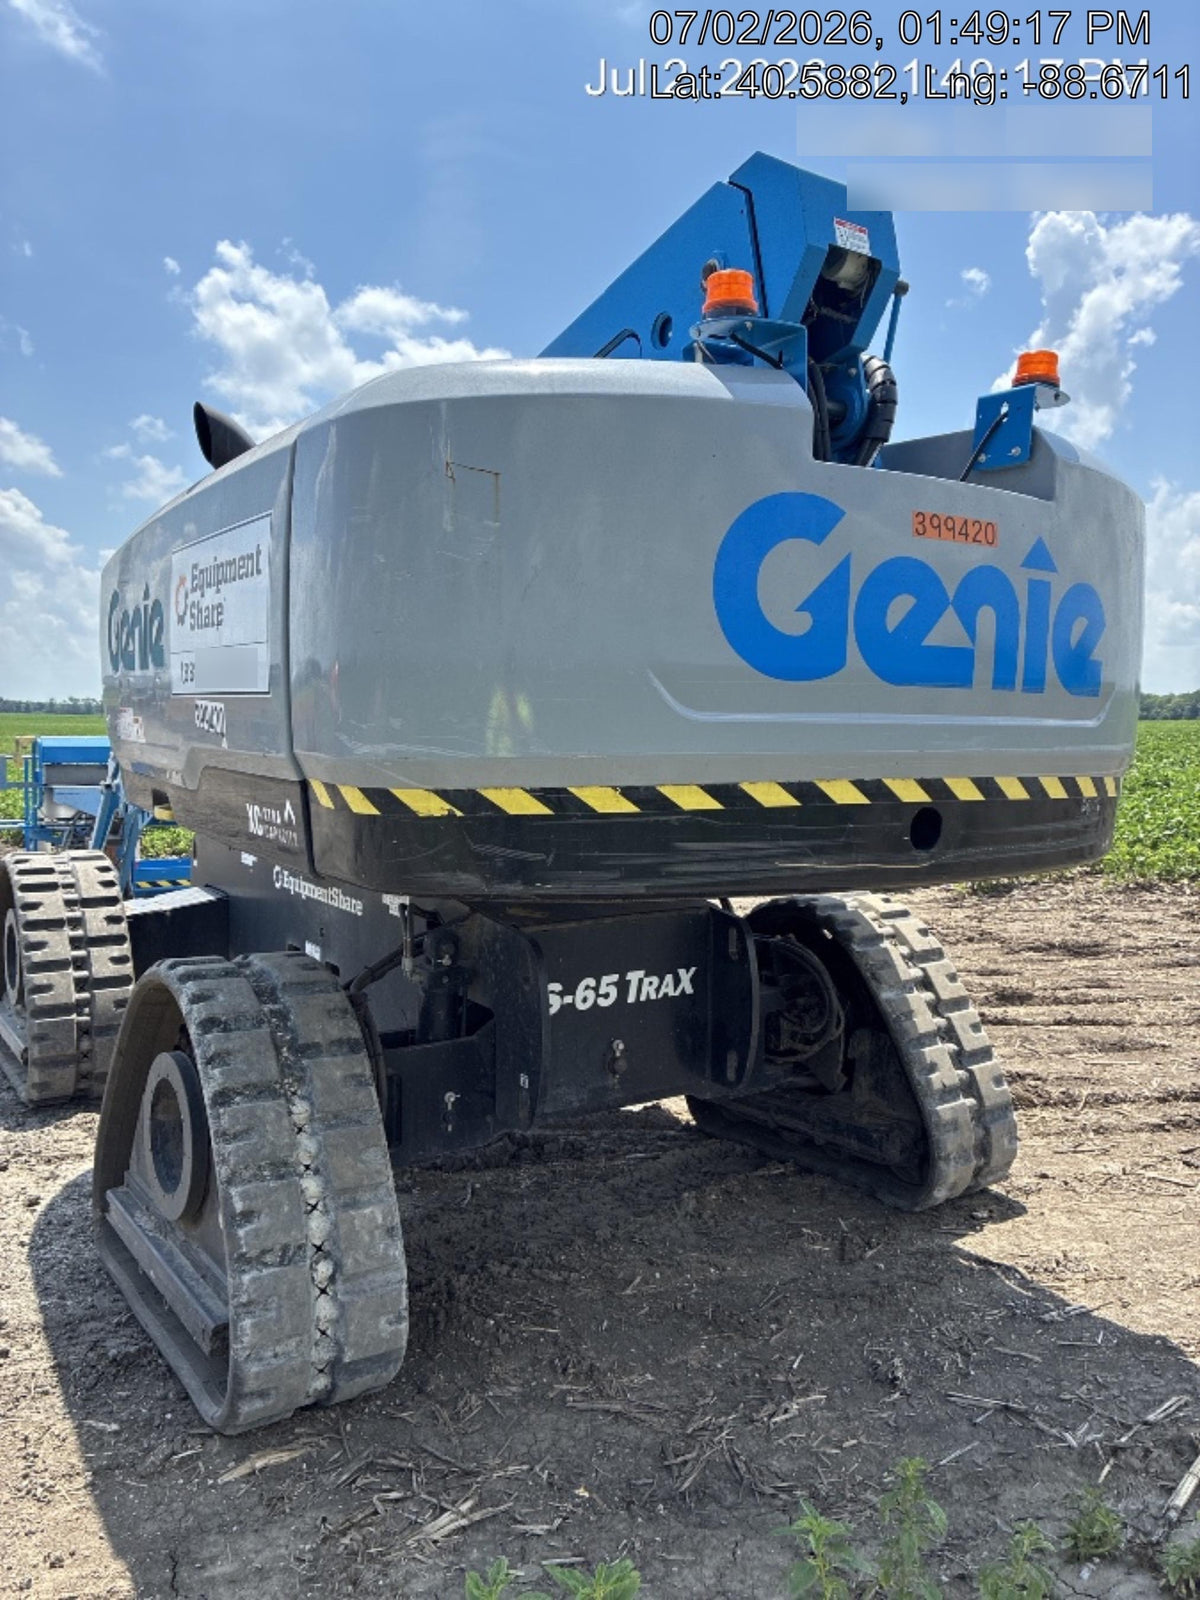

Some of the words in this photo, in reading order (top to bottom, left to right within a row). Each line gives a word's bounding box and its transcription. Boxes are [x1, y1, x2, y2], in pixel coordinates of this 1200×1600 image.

[915, 511, 995, 545] 399420
[190, 544, 262, 598] Equipment
[712, 491, 1106, 697] Genie
[108, 581, 164, 675] Genie
[190, 600, 224, 631] Share
[282, 870, 363, 916] EquipmentShare
[547, 974, 620, 1015] S-65
